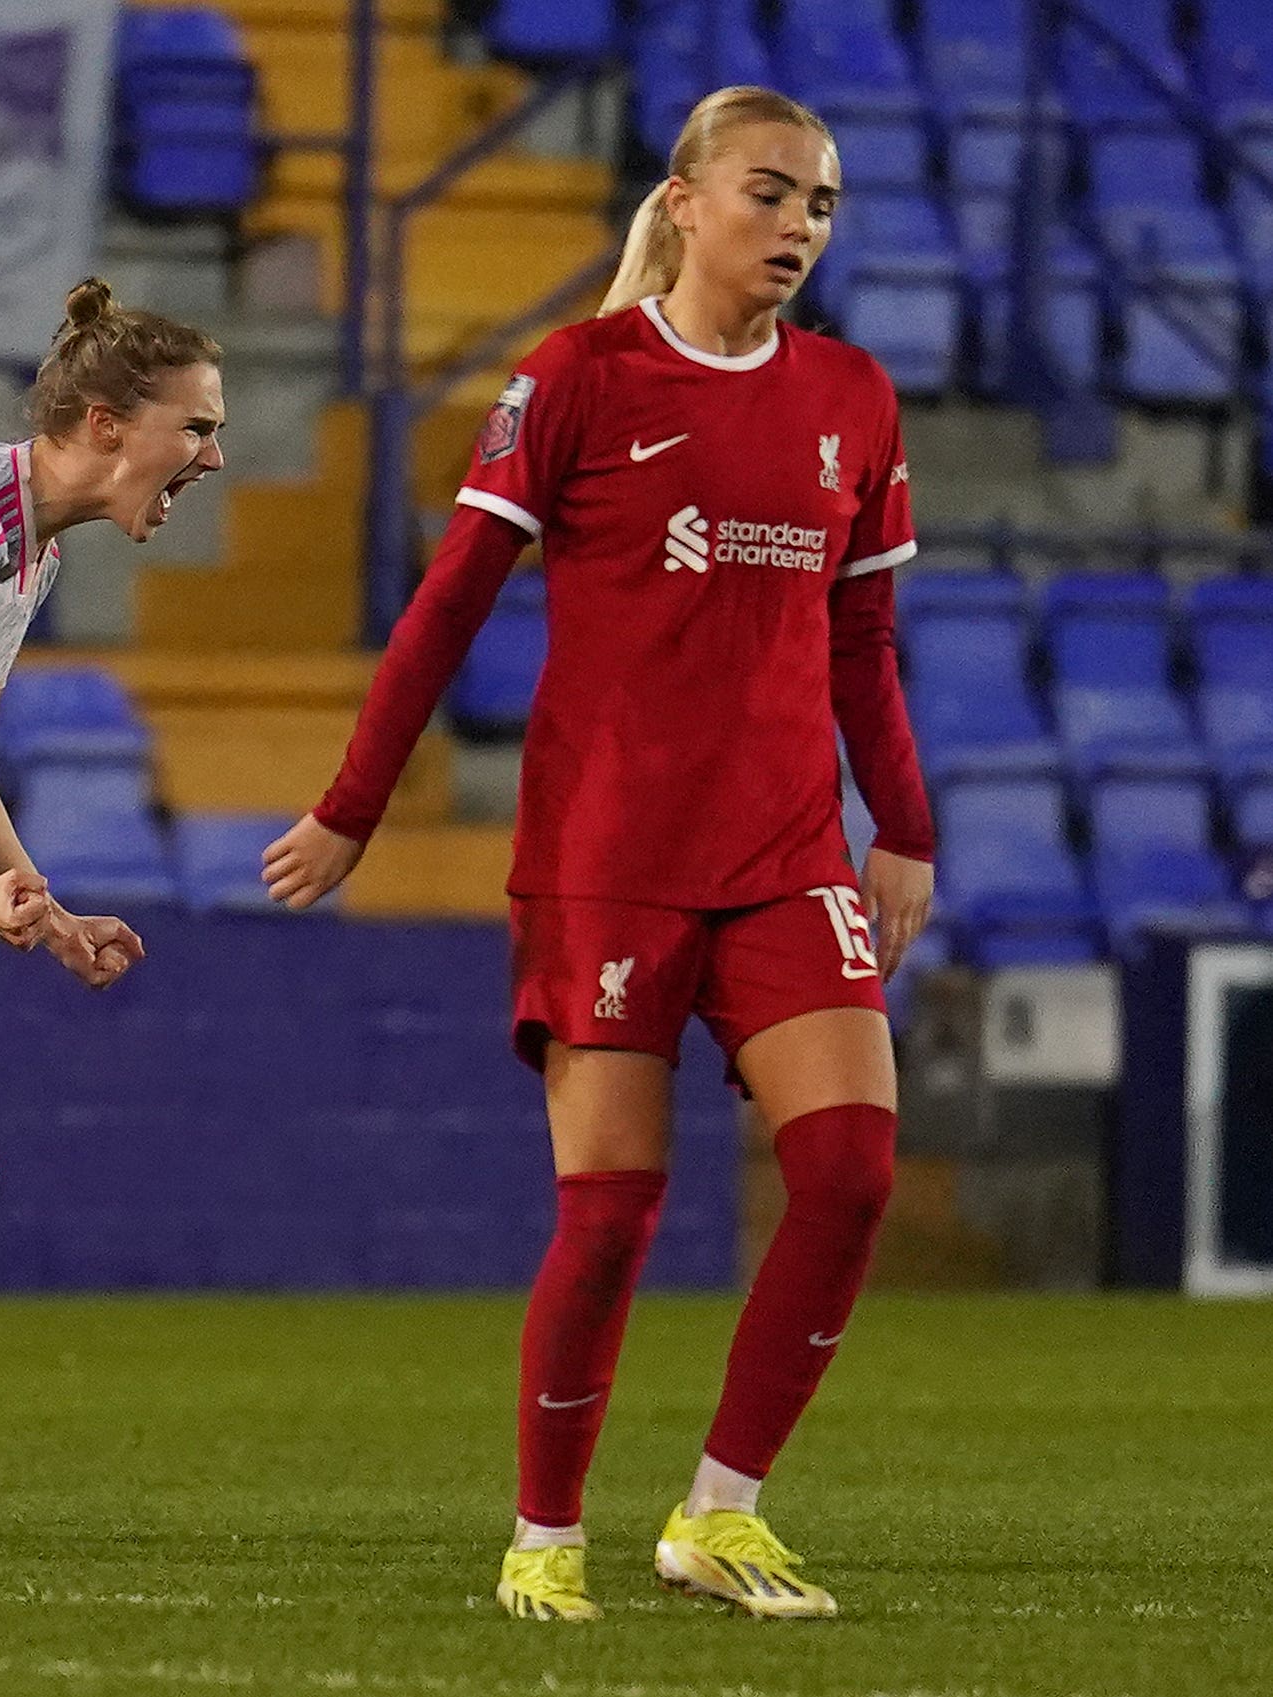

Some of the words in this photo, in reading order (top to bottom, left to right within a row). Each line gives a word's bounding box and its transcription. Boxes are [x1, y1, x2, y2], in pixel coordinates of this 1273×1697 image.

[716, 517, 827, 550] standard
[714, 541, 826, 573] chartered
[806, 885, 879, 980] 15
